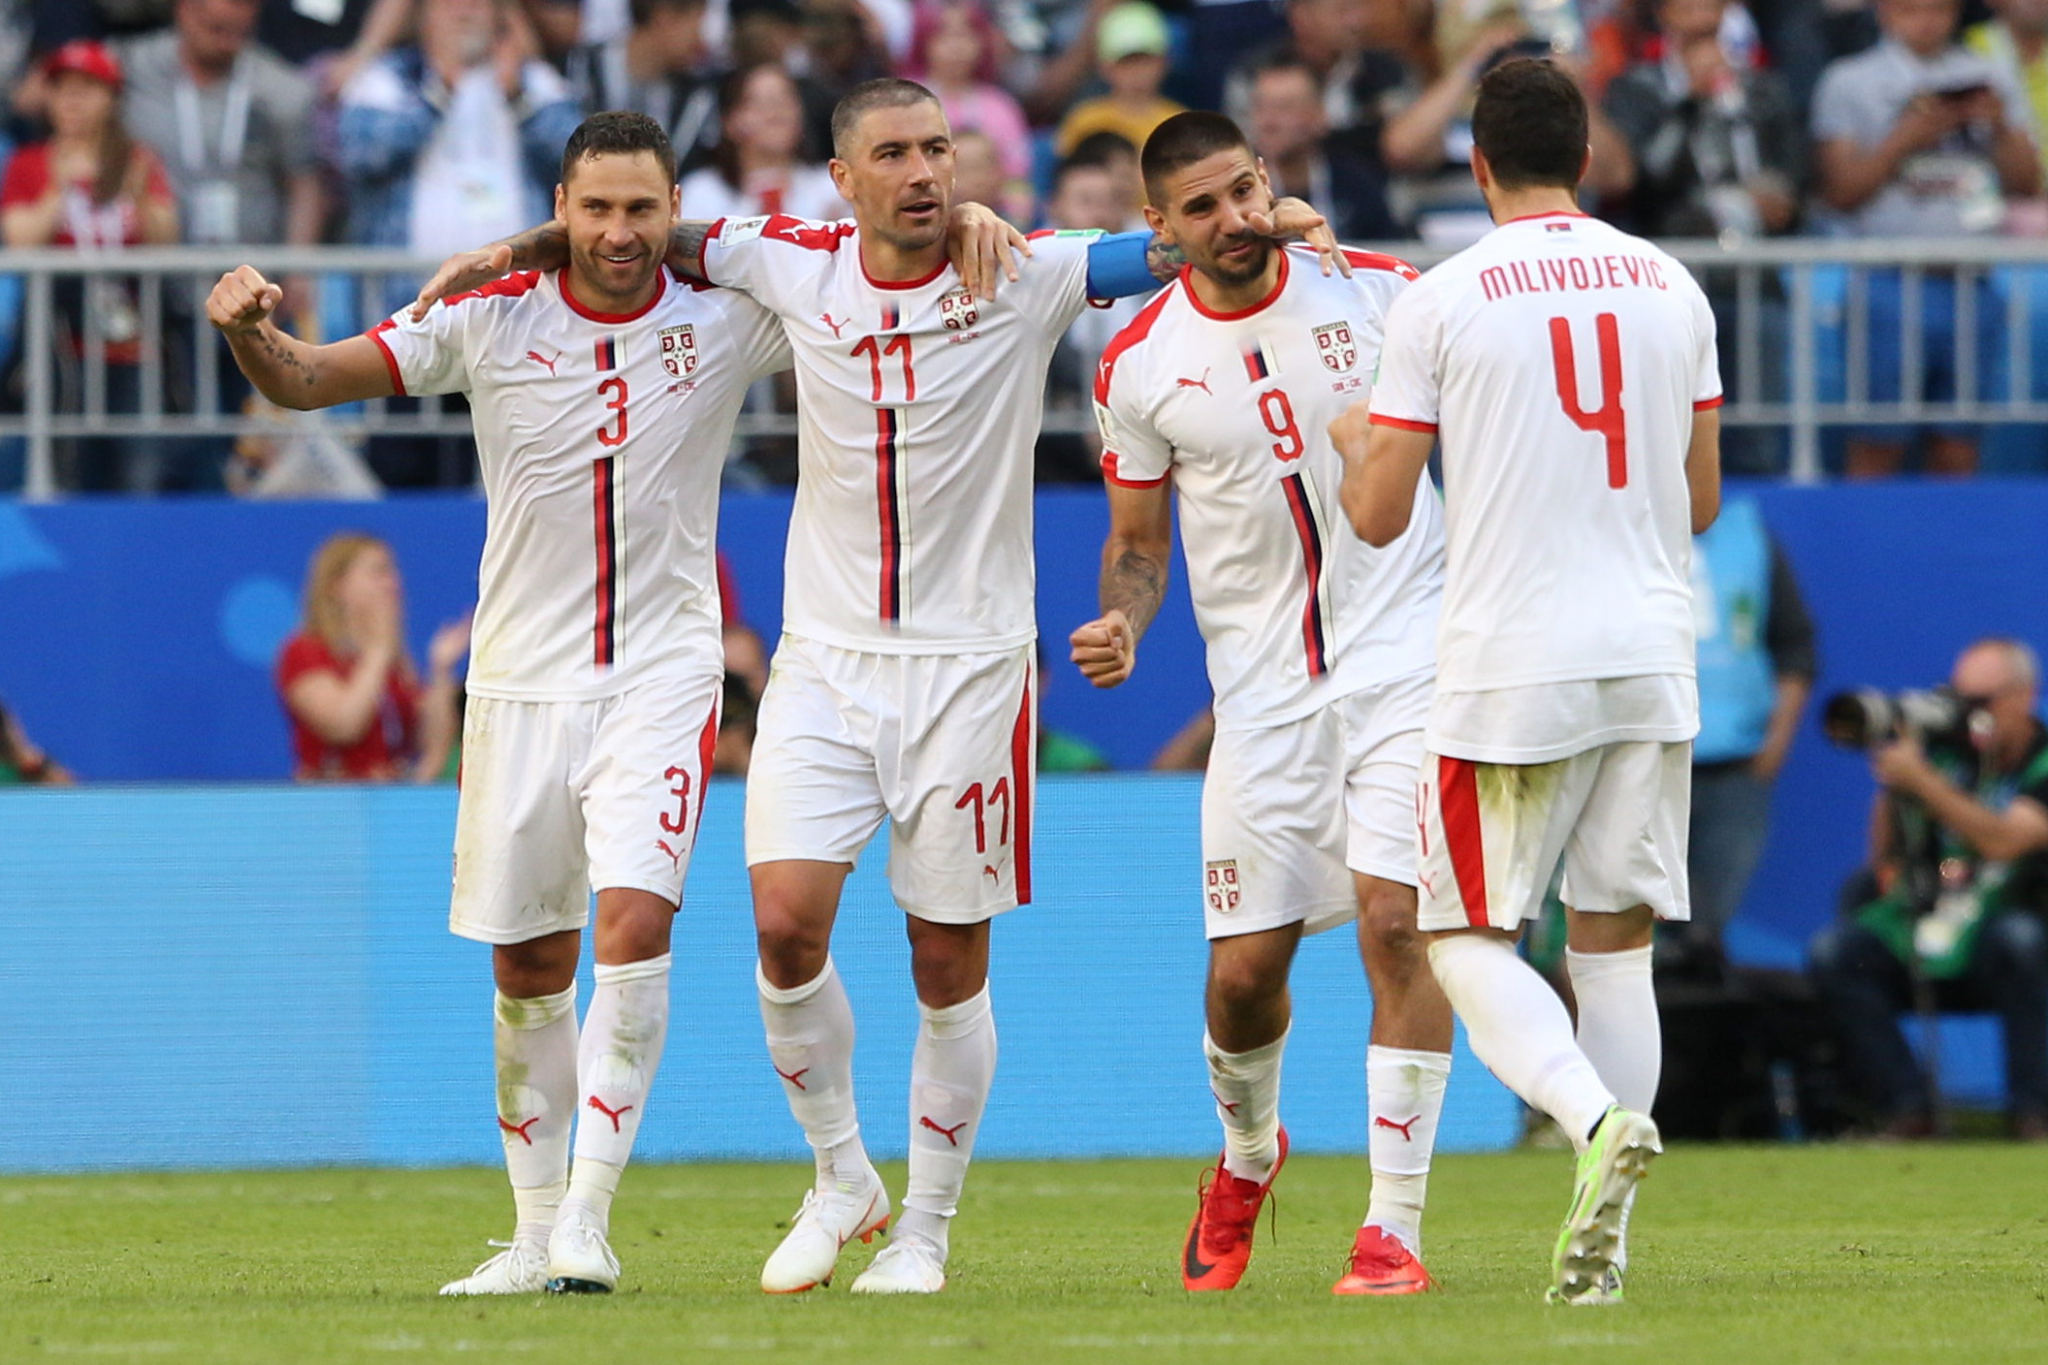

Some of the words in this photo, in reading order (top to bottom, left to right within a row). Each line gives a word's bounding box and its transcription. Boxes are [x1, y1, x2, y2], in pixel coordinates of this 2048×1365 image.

[850, 333, 915, 402] 11
[1548, 312, 1628, 490] 4
[597, 377, 628, 447] 3
[1258, 387, 1304, 463] 9
[660, 765, 690, 835] 3
[955, 776, 1010, 854] 11
